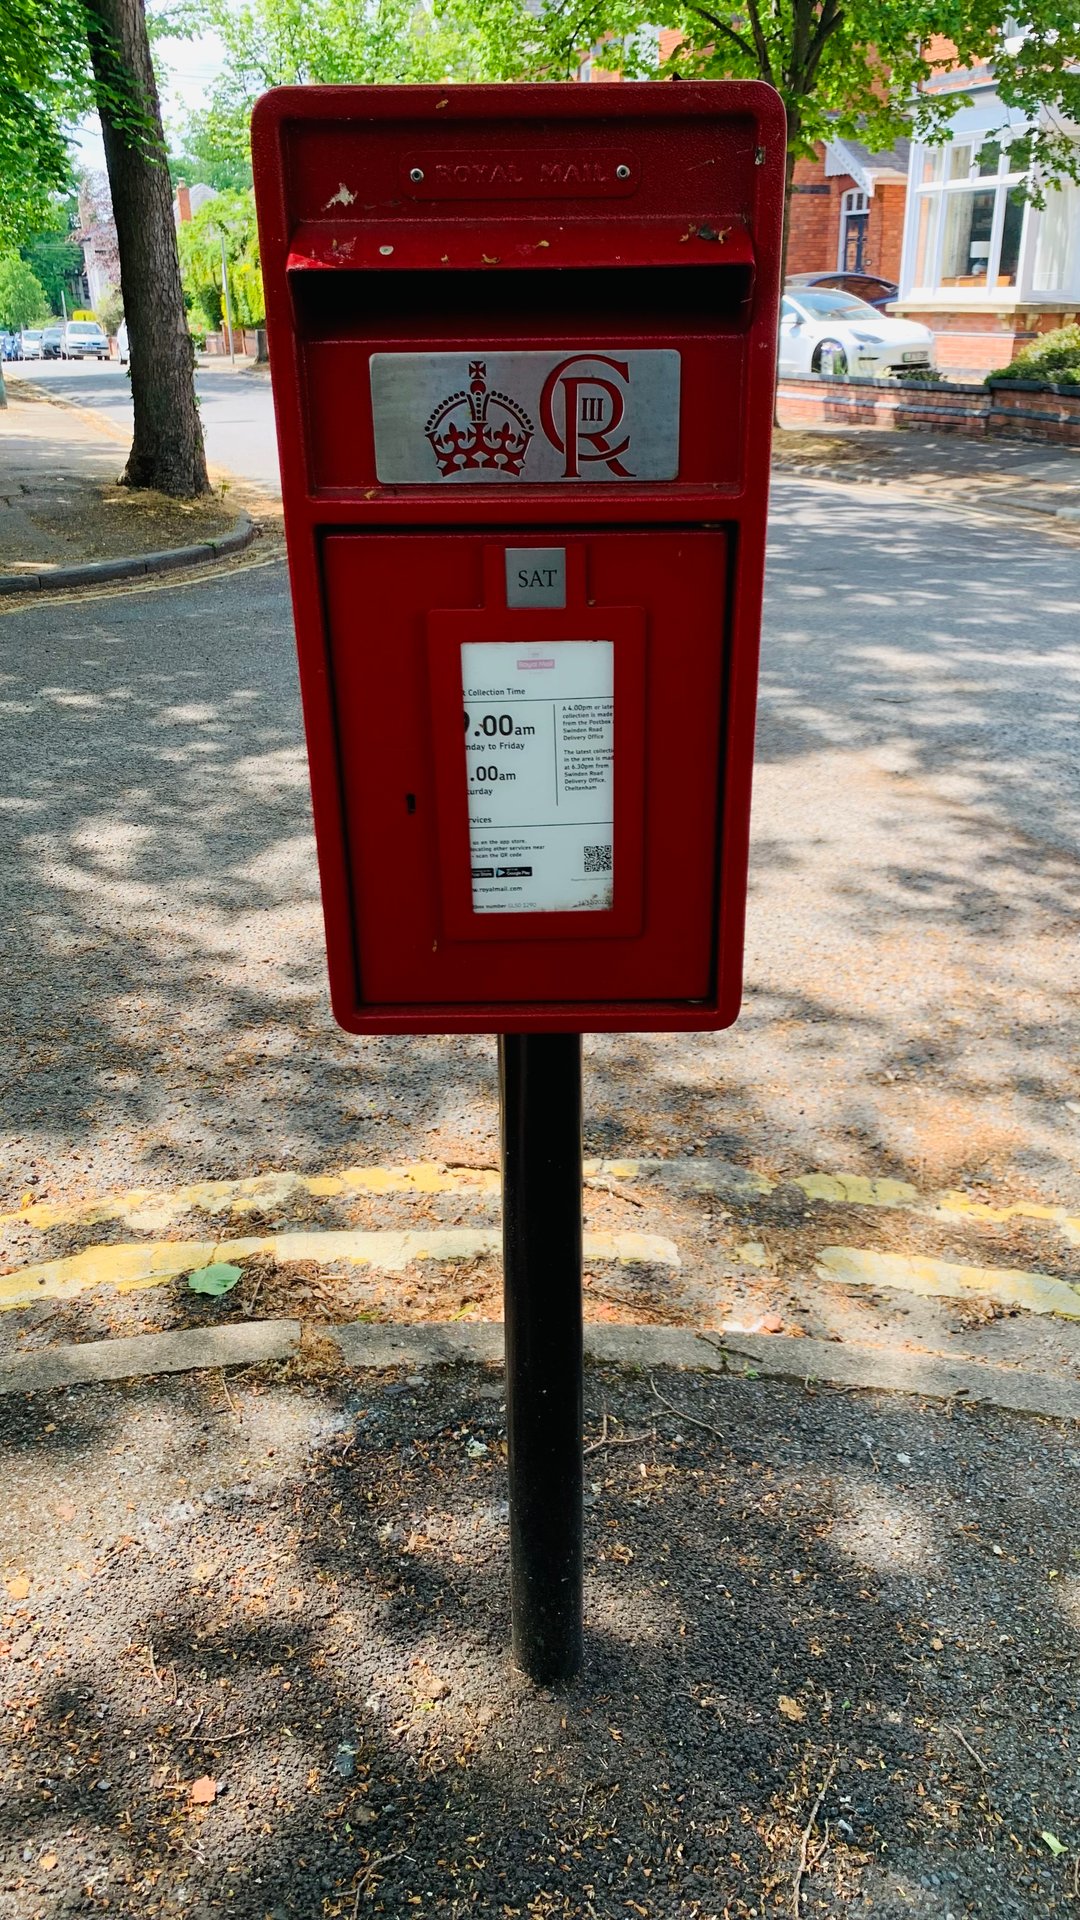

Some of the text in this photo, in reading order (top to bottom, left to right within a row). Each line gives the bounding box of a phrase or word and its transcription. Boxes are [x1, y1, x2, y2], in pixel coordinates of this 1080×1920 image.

[435, 162, 609, 184] ROYAL MAIL
[518, 569, 558, 588] SAT
[500, 742, 525, 750] Friday
